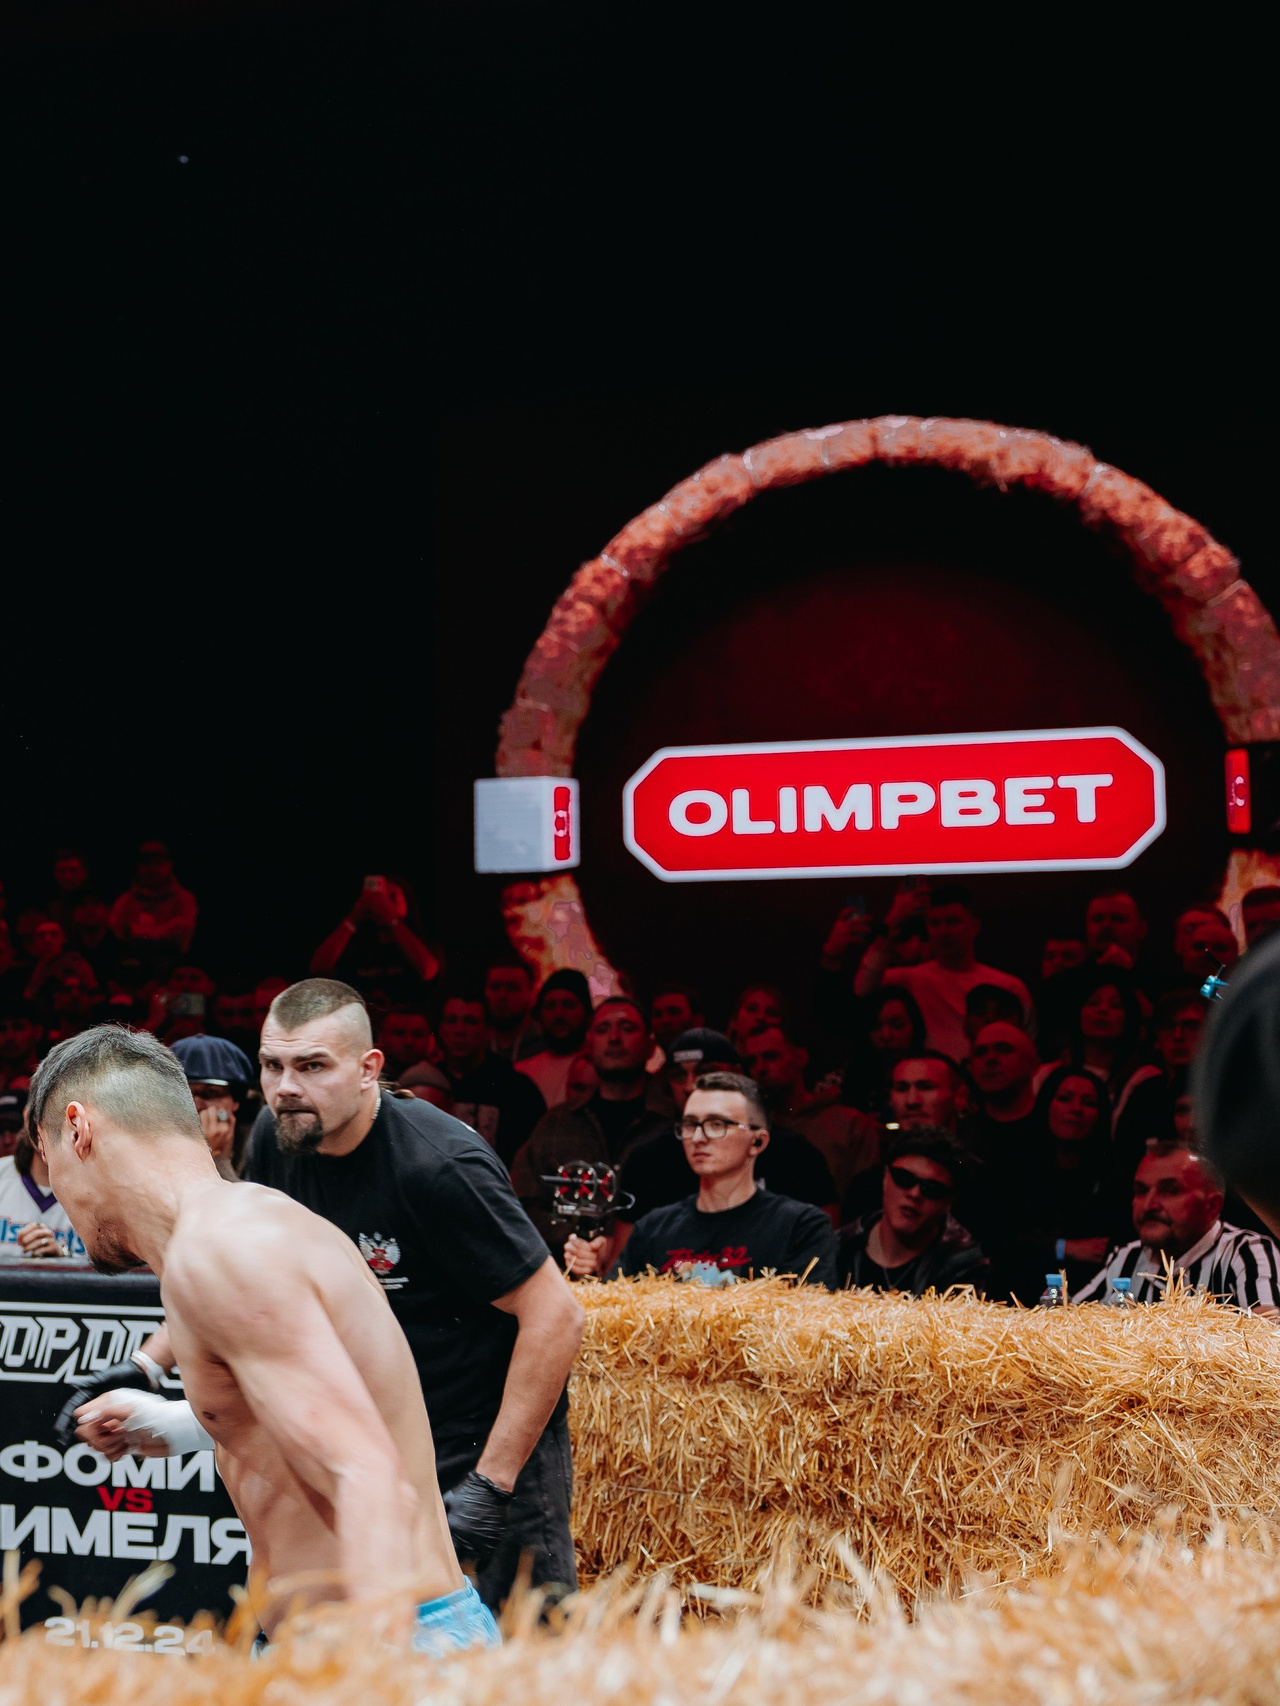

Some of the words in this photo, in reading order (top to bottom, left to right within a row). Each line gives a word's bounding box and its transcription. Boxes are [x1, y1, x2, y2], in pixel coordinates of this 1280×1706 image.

[667, 773, 1114, 838] OLIMPBET
[96, 1486, 154, 1513] VS
[43, 1616, 216, 1656] 21.12.24
